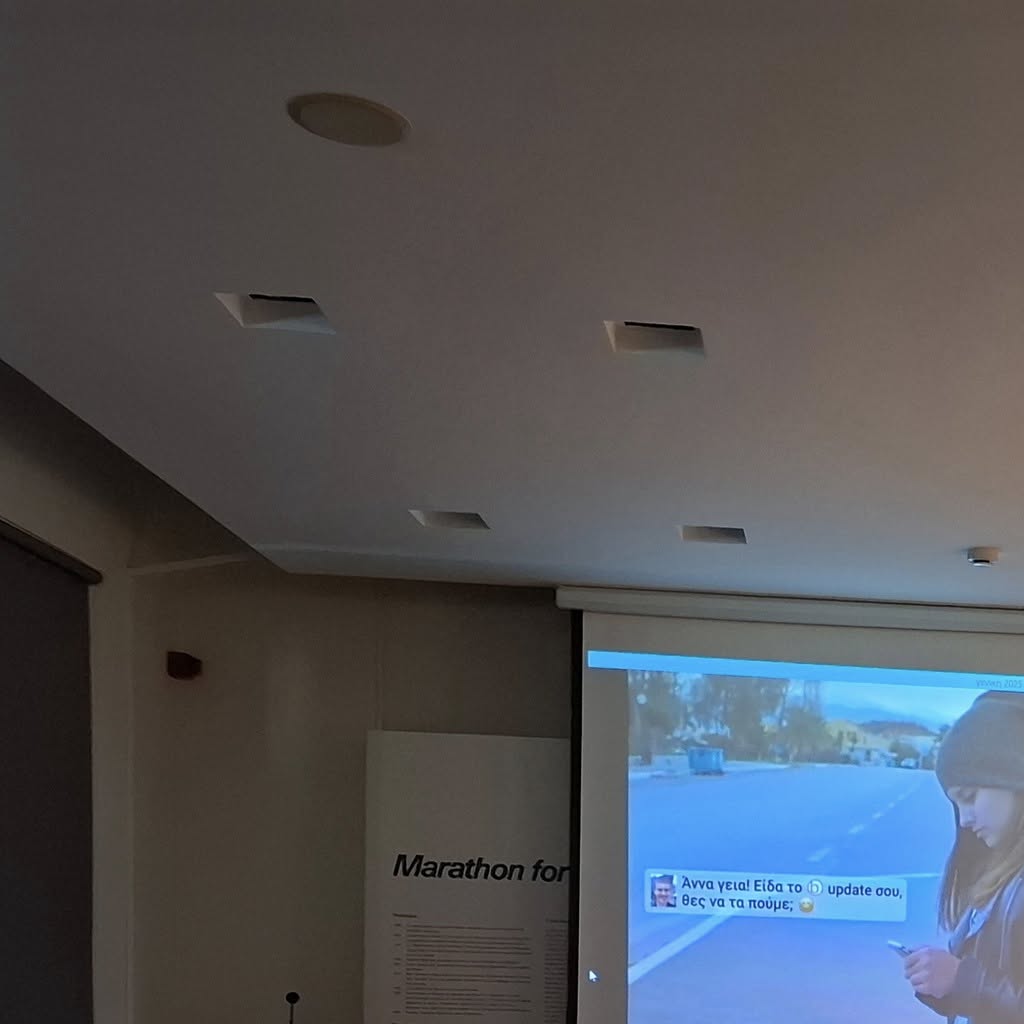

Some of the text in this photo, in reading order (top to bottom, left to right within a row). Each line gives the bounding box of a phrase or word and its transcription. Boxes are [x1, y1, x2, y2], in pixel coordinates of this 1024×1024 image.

[393, 854, 571, 882] Marathon for
[681, 876, 714, 890] Άννα
[718, 879, 750, 895] γεια!
[754, 879, 783, 893] Είδα
[787, 882, 802, 893] το
[828, 883, 872, 898] update
[875, 887, 903, 899] σου,
[681, 894, 794, 911] θες να τα πούμε;
